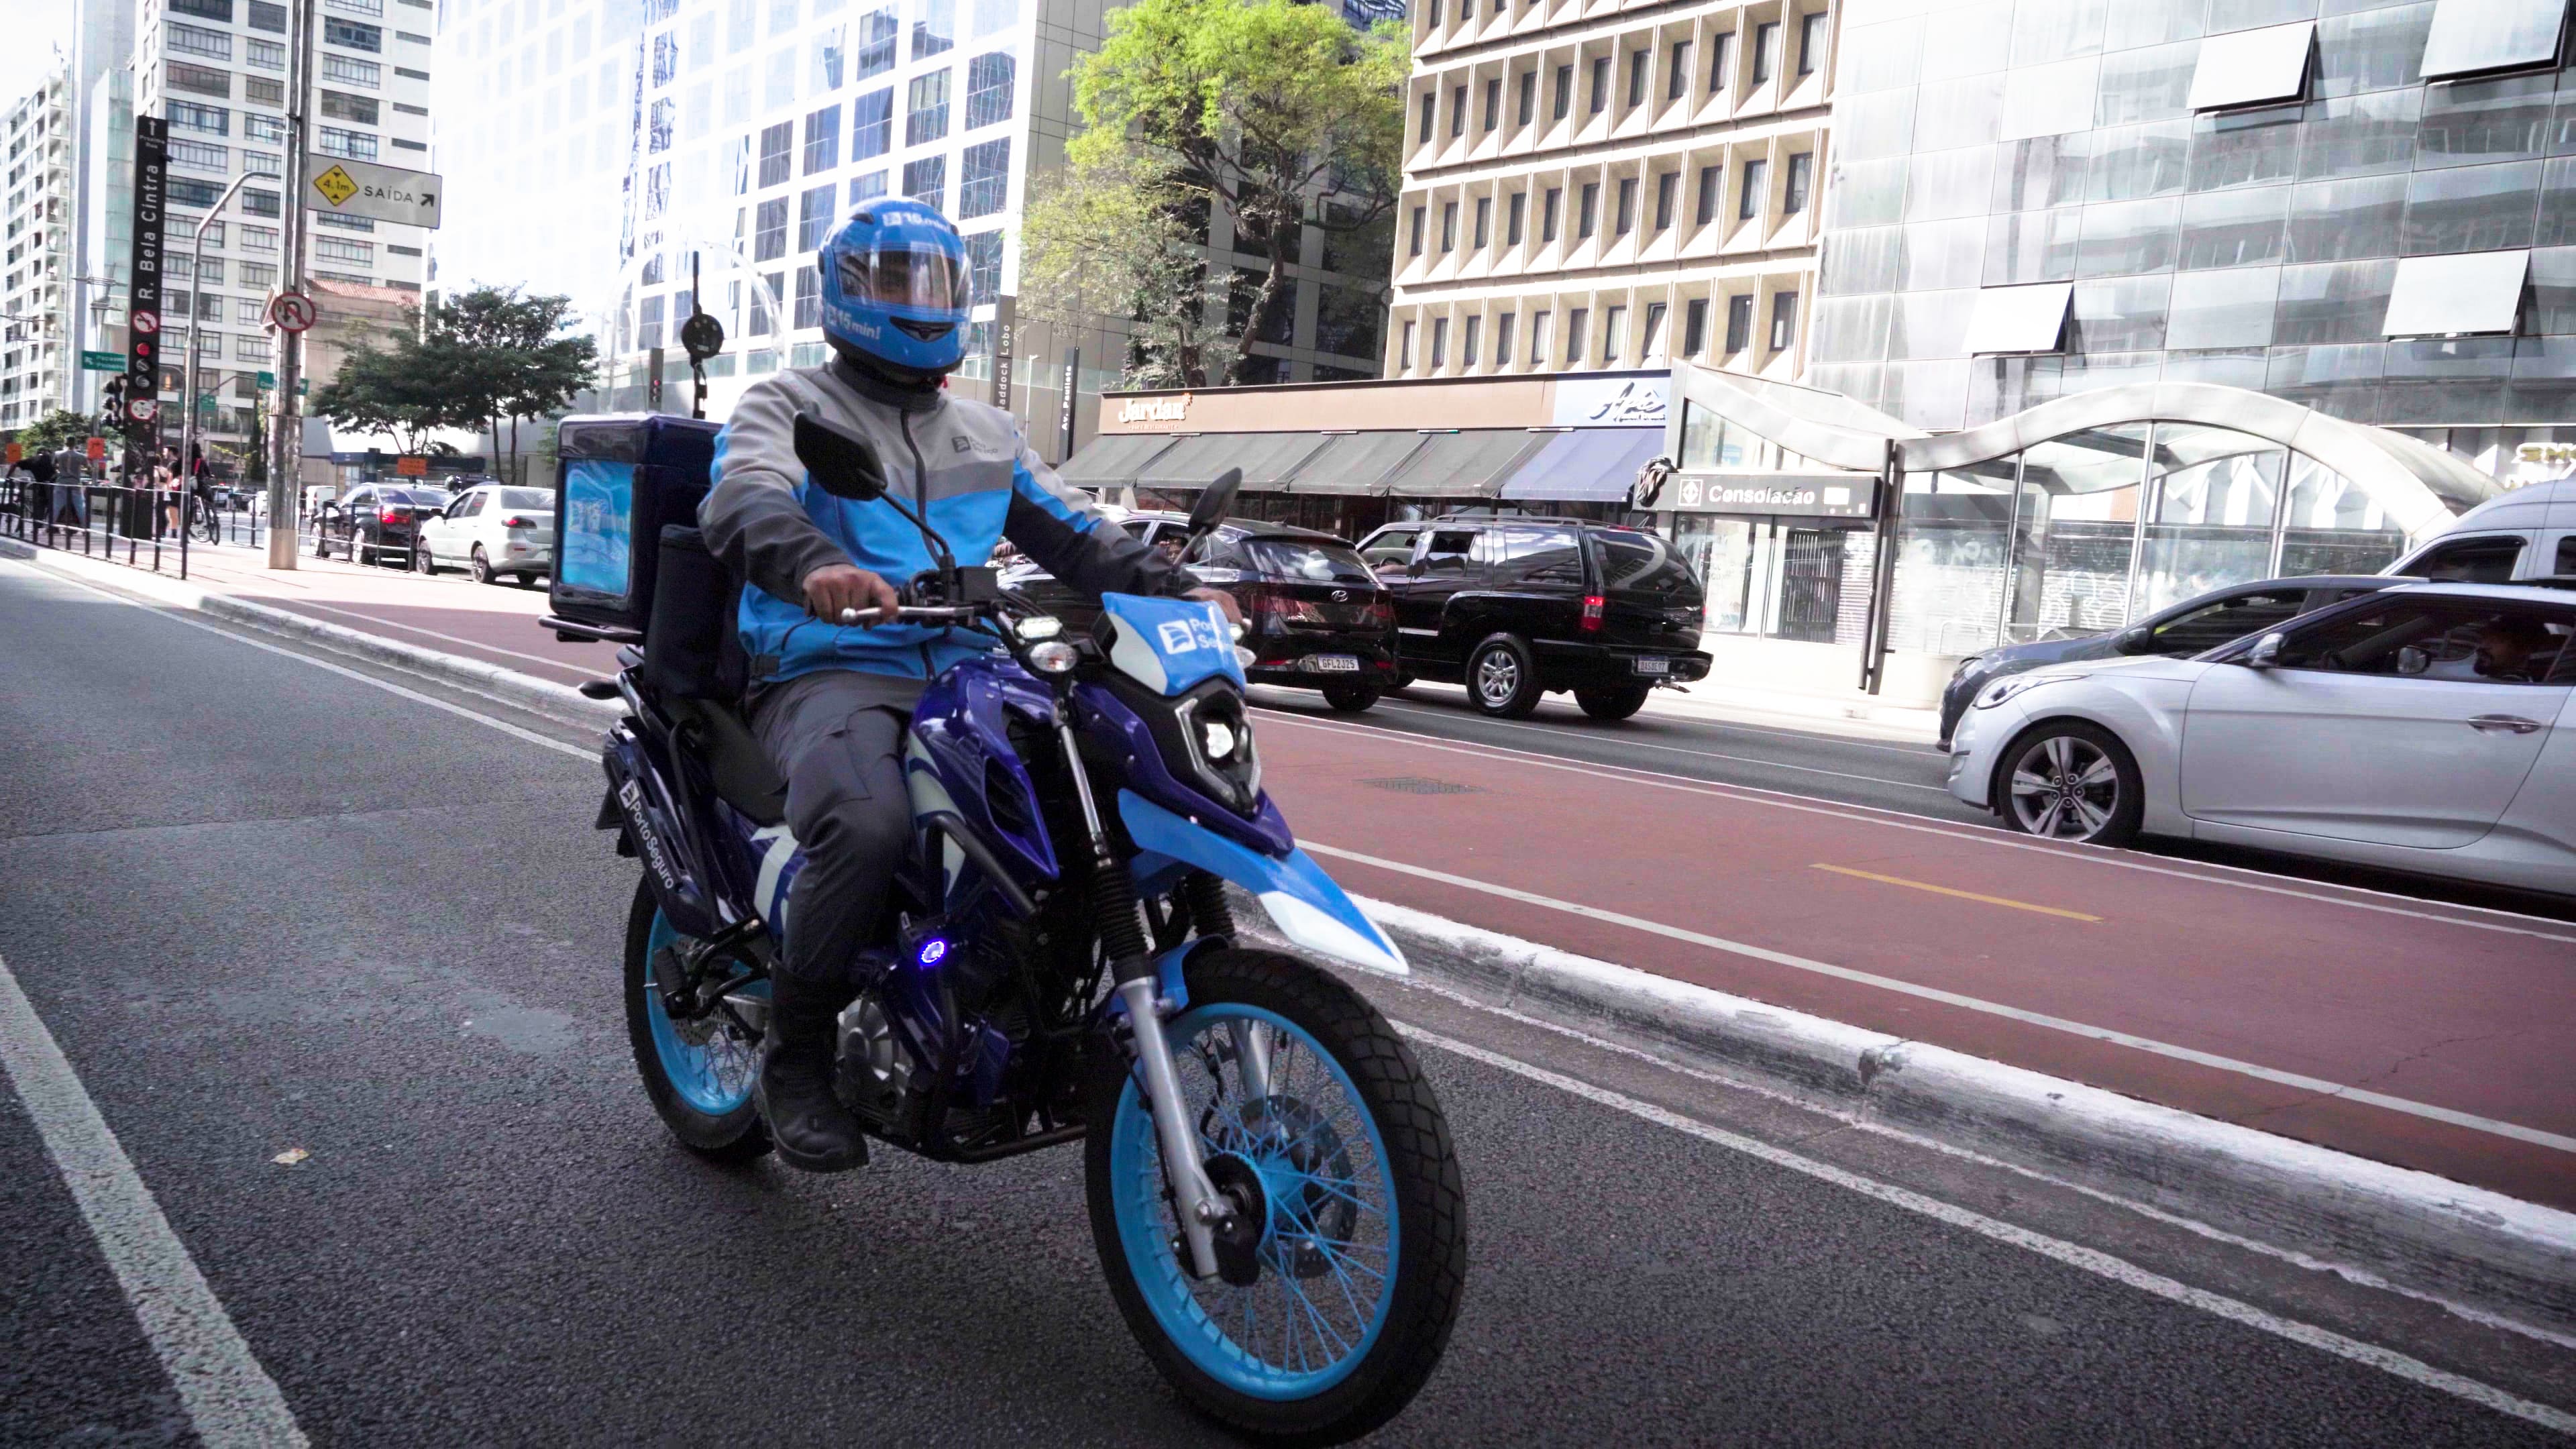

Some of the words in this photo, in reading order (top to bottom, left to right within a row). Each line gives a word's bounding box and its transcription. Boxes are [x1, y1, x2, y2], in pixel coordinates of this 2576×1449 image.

[141, 164, 158, 221] Cintra
[364, 186, 413, 203] SAÍDA
[140, 232, 156, 272] Bela
[139, 282, 154, 299] R.
[1000, 325, 1010, 356] Lobo
[998, 363, 1008, 409] addock
[1063, 365, 1072, 409] Paulista
[1709, 485, 1815, 506] Consolação
[1322, 659, 1355, 669] GFL2J25
